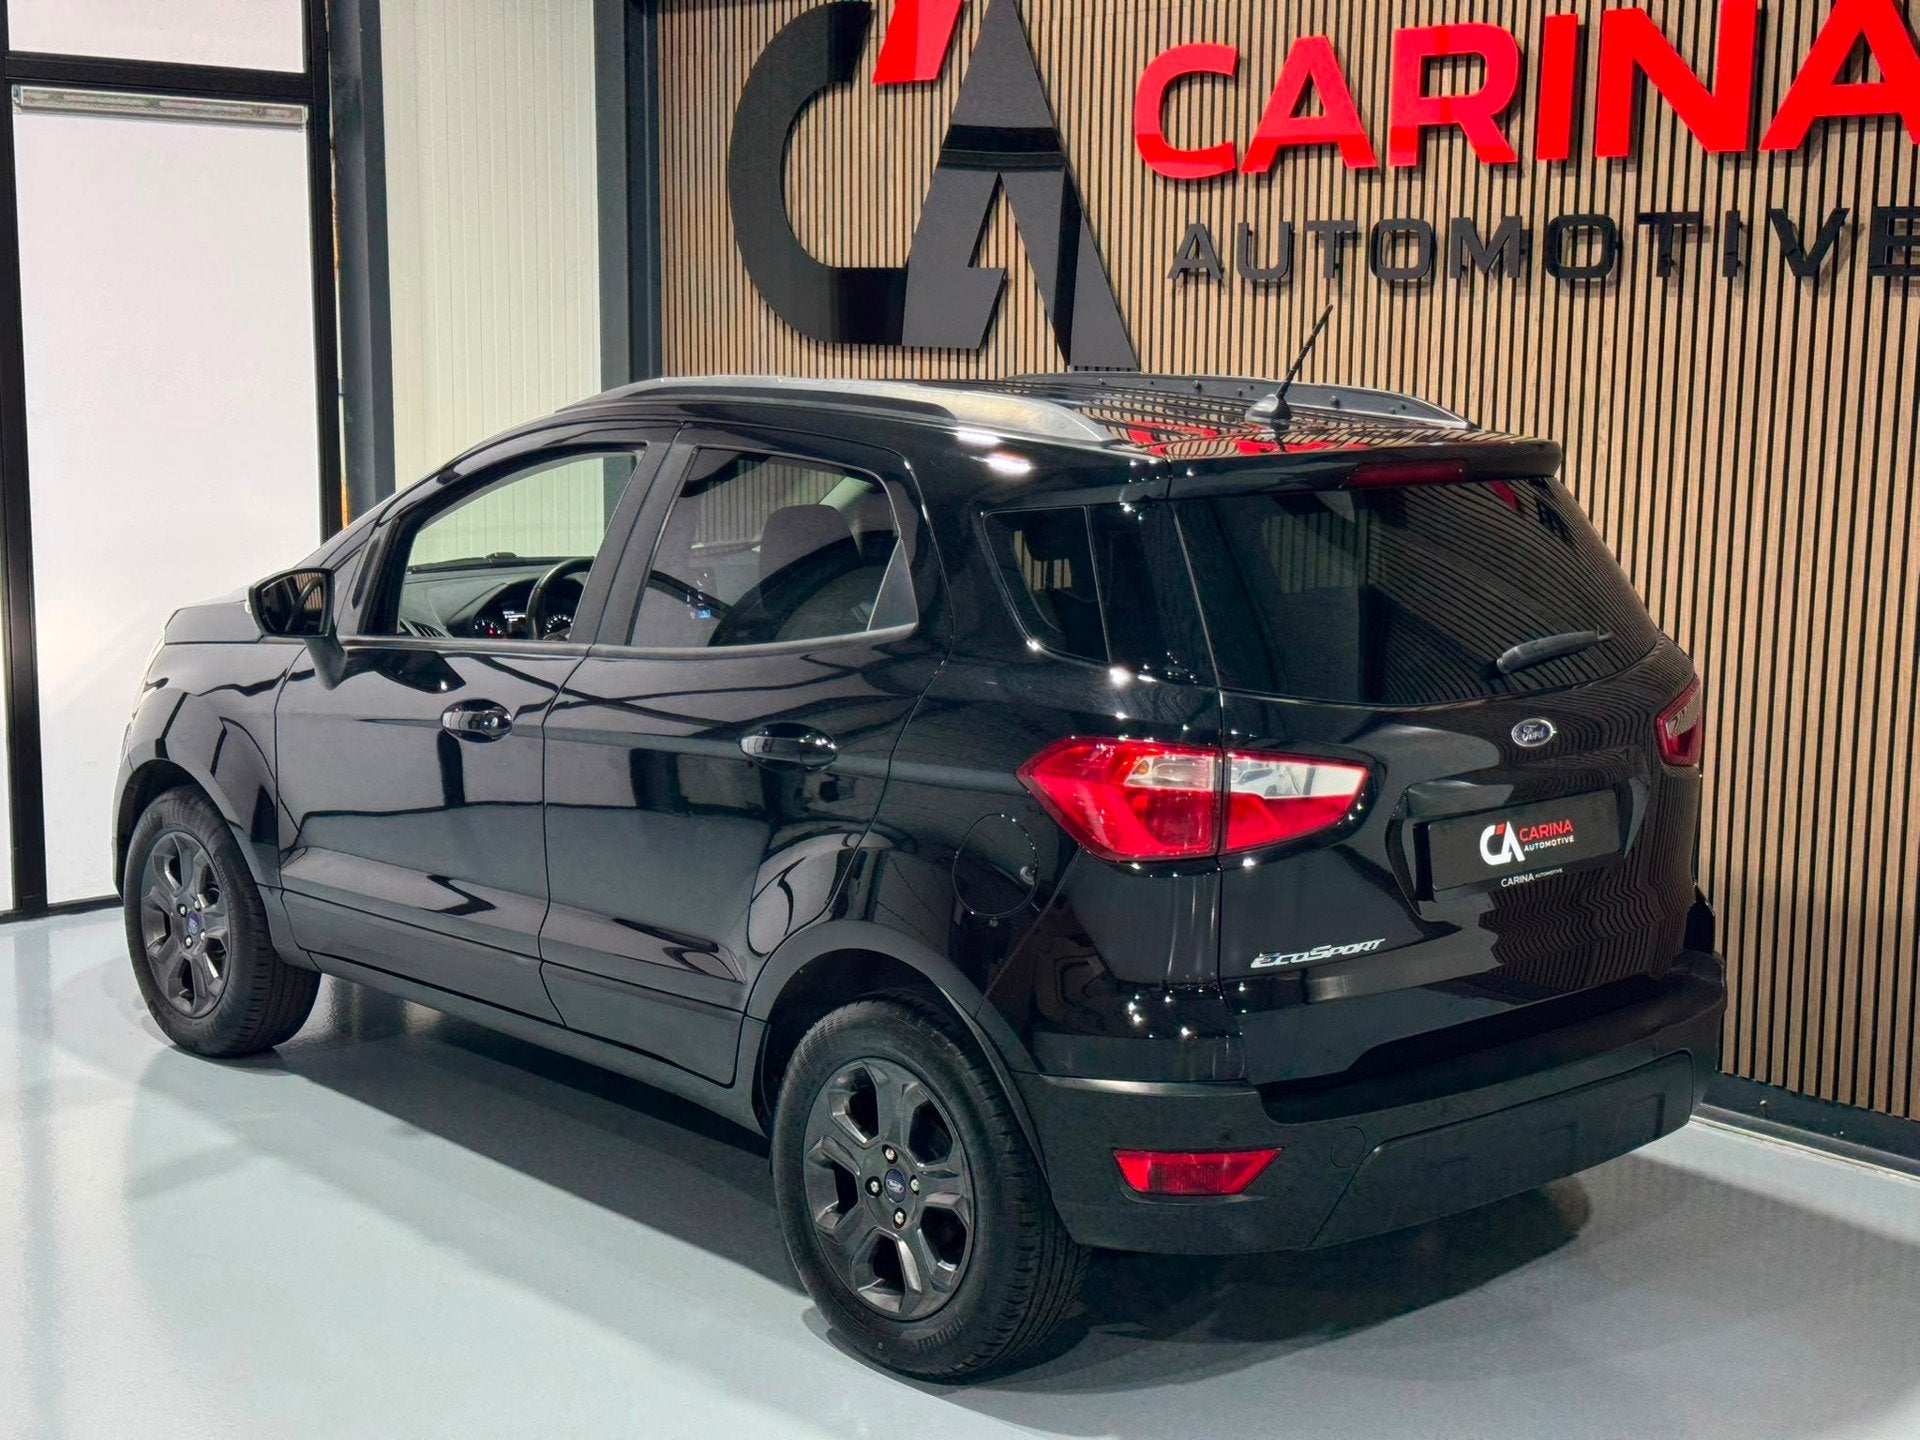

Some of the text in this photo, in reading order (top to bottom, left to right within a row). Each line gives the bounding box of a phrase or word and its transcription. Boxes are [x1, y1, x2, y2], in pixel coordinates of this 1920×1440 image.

[1134, 0, 1920, 179] CARINA
[1167, 206, 1920, 281] AUTOMOTIVE
[1519, 819, 1574, 842] CARINA
[1523, 835, 1575, 852] AUTOMOTIVE
[1500, 872, 1535, 888] CARINA
